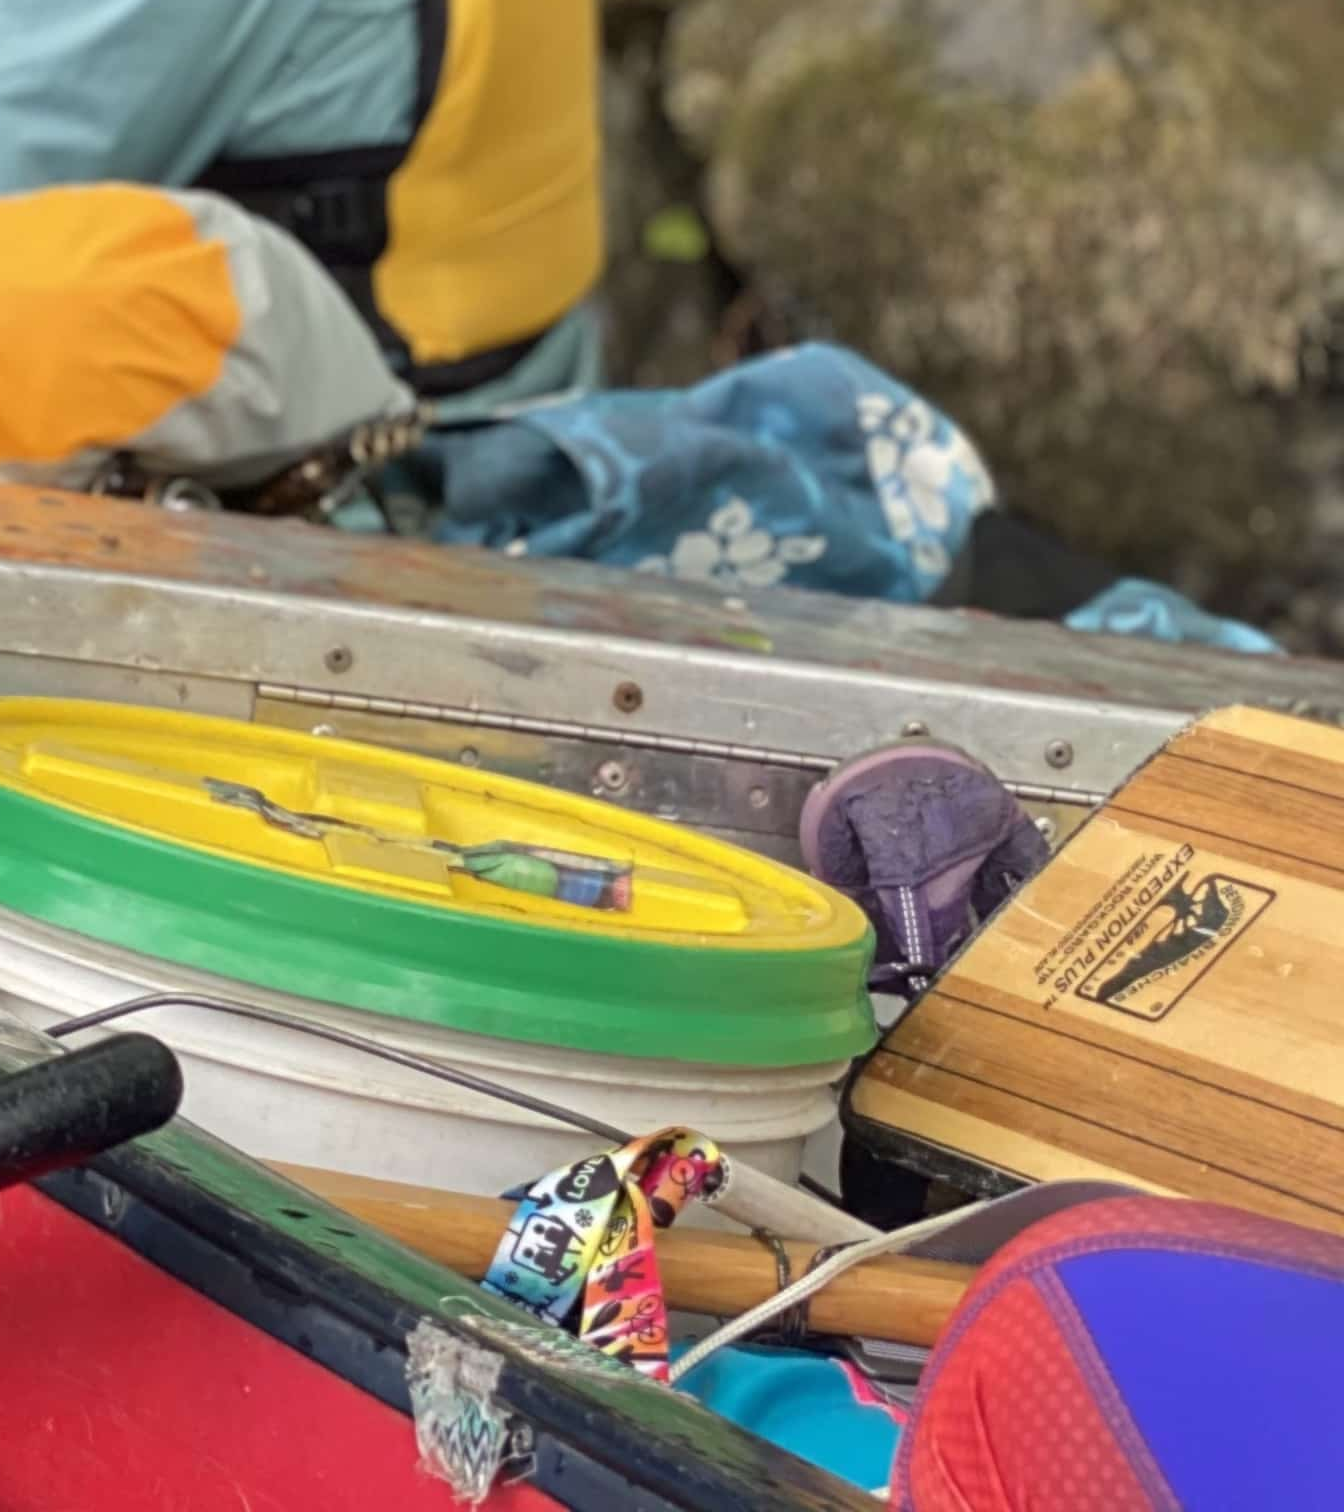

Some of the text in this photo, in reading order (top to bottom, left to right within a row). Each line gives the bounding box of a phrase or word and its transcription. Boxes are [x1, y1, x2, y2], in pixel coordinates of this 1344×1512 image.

[1132, 853, 1165, 884] WITH
[1095, 843, 1194, 952] EXPEDITION
[1218, 884, 1246, 938] BENDING
[1037, 966, 1062, 986] TIP
[1054, 952, 1095, 993] PLUS
[1114, 939, 1217, 1003] BRANCHES
